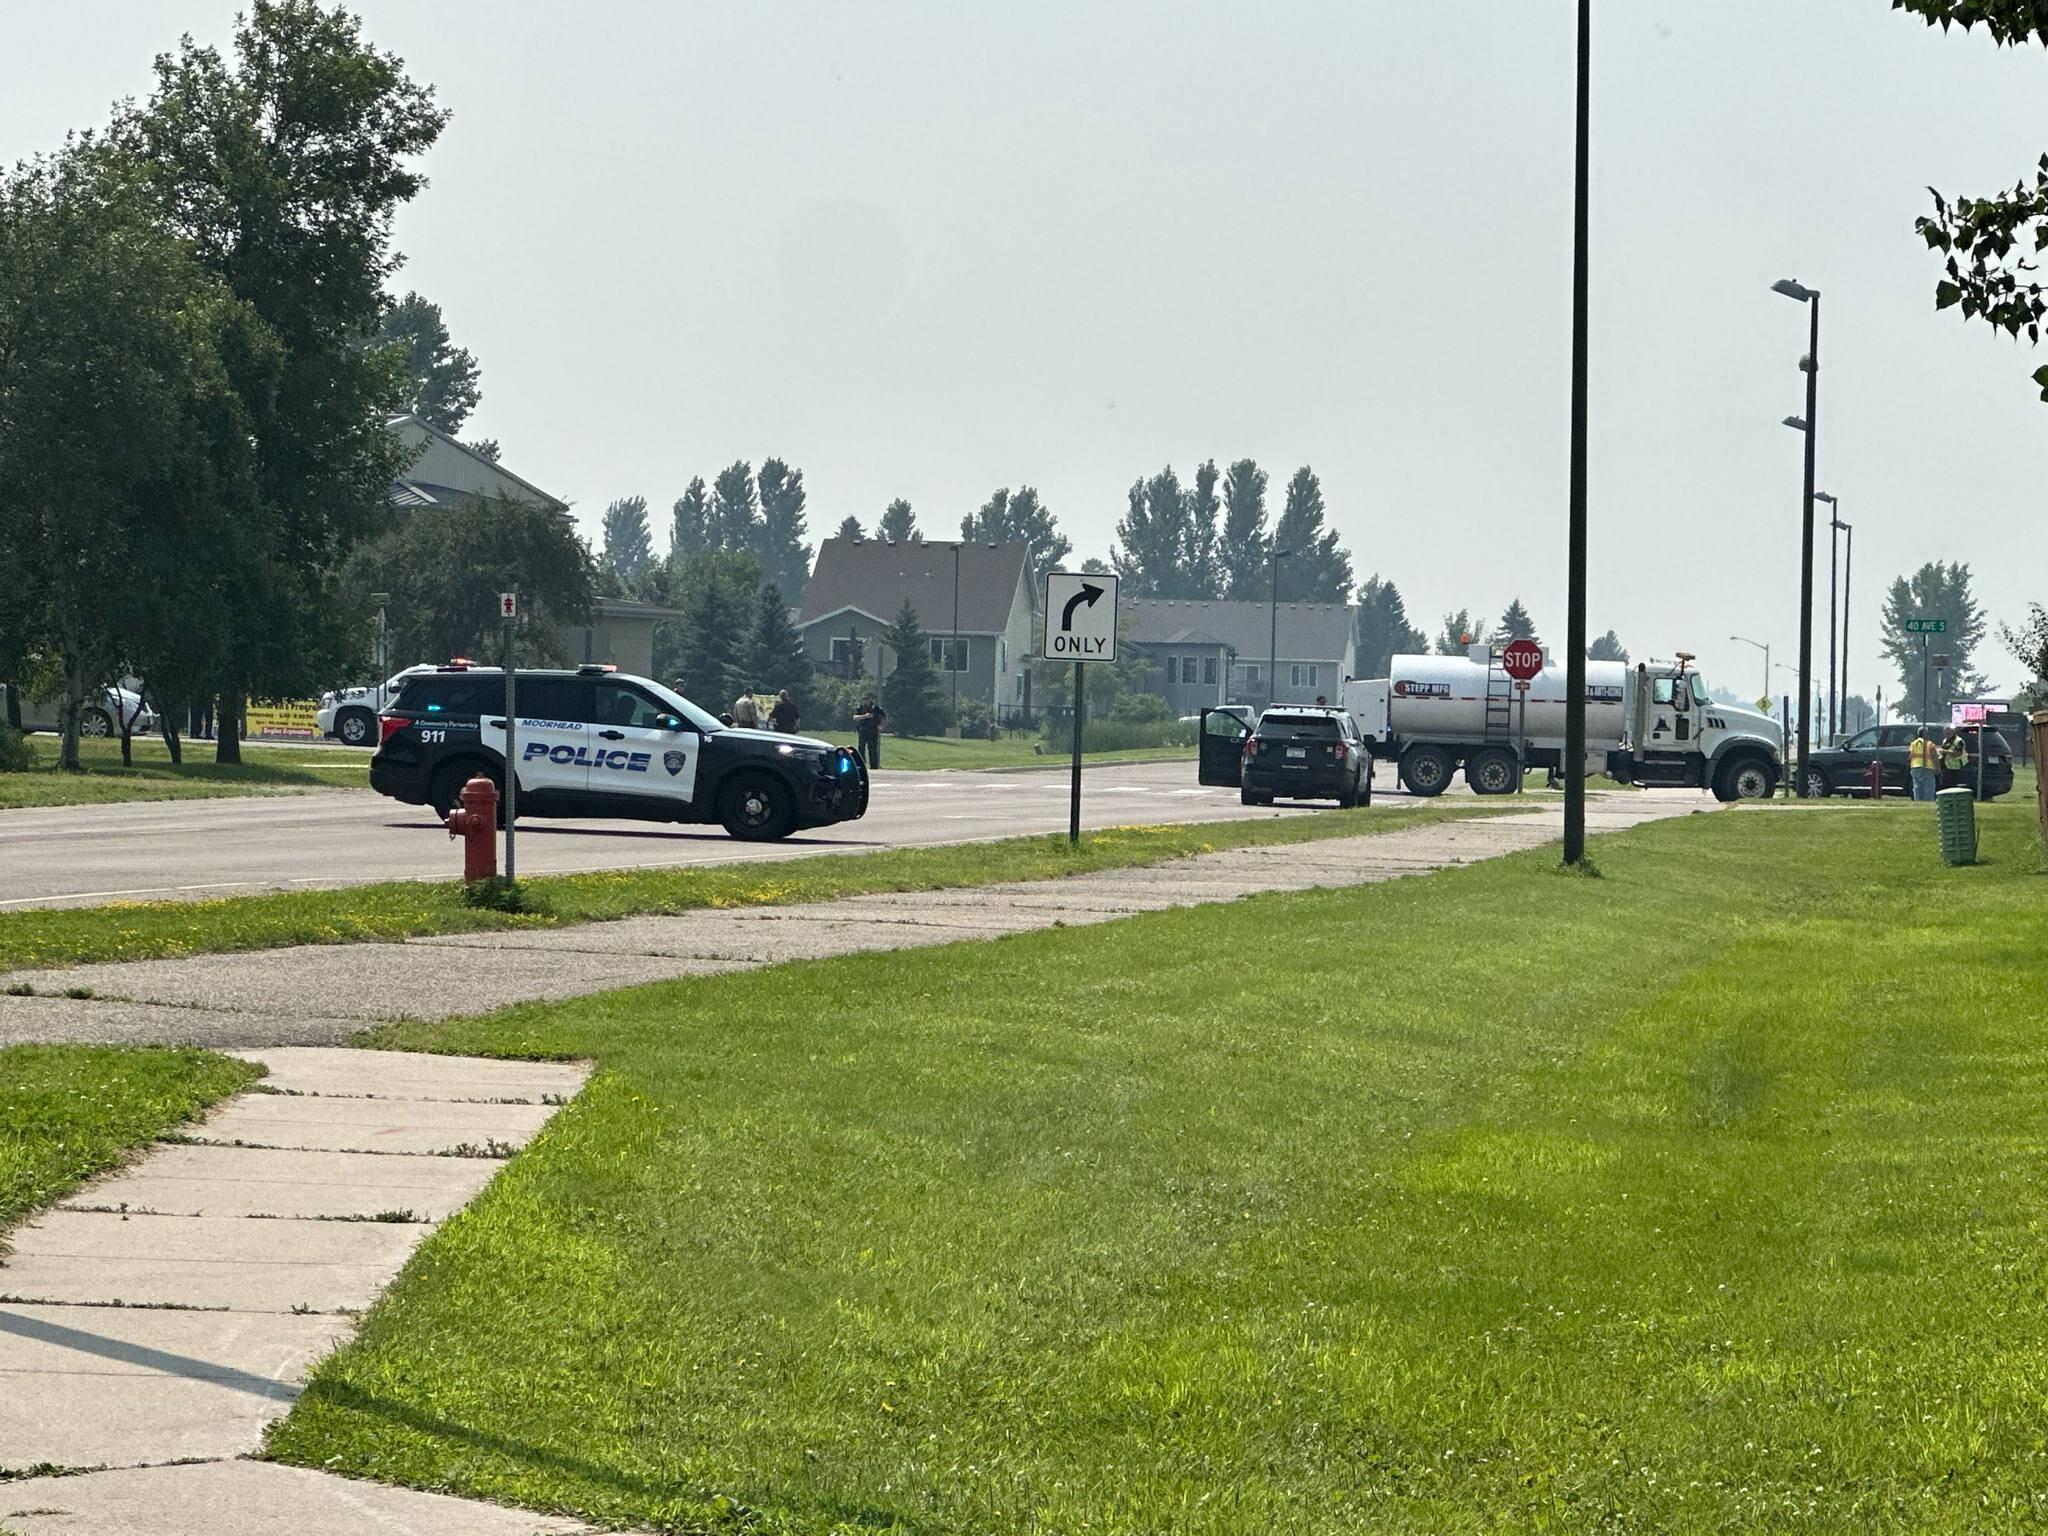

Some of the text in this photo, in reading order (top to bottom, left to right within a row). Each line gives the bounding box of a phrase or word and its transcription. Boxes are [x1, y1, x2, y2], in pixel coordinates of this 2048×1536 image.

[1907, 622, 1945, 631] 40 AVE S
[1054, 636, 1106, 653] ONLY
[1505, 652, 1540, 668] STOP
[522, 719, 583, 730] MOORHEAD
[421, 730, 445, 743] 911
[523, 743, 651, 772] POLICE
